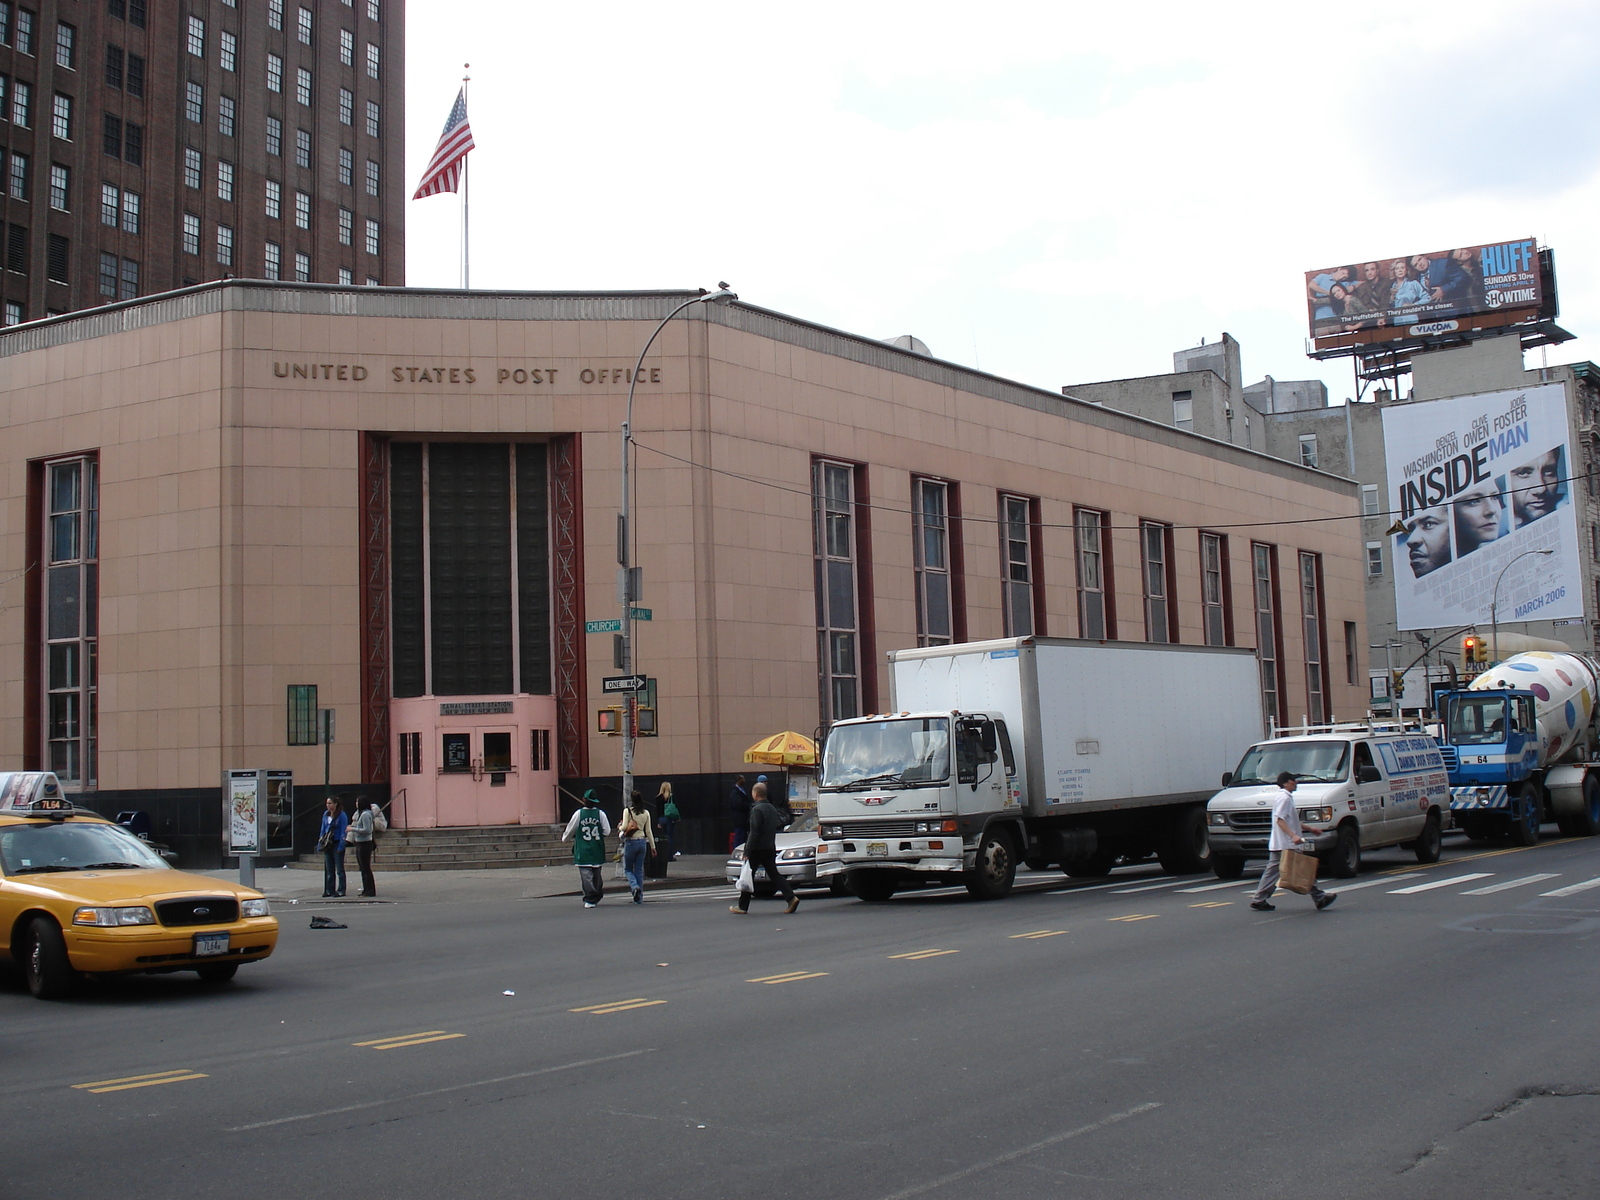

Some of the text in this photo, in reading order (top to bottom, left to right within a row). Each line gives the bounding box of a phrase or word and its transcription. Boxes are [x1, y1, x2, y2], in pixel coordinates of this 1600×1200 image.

[1481, 240, 1533, 277] HUFF
[1484, 274, 1517, 285] SUNDAYS
[1484, 282, 1512, 291] STARTING
[1485, 287, 1537, 308] SHOWTIME
[1416, 322, 1452, 333] VIACOM
[274, 362, 661, 384] UNITED STATES POST OFFICE
[1510, 393, 1526, 410] JODIE
[1471, 413, 1489, 430] CLIVE
[1403, 404, 1528, 480] WASHINGTON OWEN FOSTER
[1435, 430, 1458, 449] DENZEL
[1399, 420, 1529, 521] INSIDE MAN
[1514, 585, 1566, 619] MARCH 2006
[587, 621, 614, 632] CHURCH
[626, 679, 640, 687] WAY
[1477, 756, 1487, 764] 64
[42, 800, 60, 809] 7L64
[580, 817, 600, 827] PIERCE
[582, 826, 600, 841] 34
